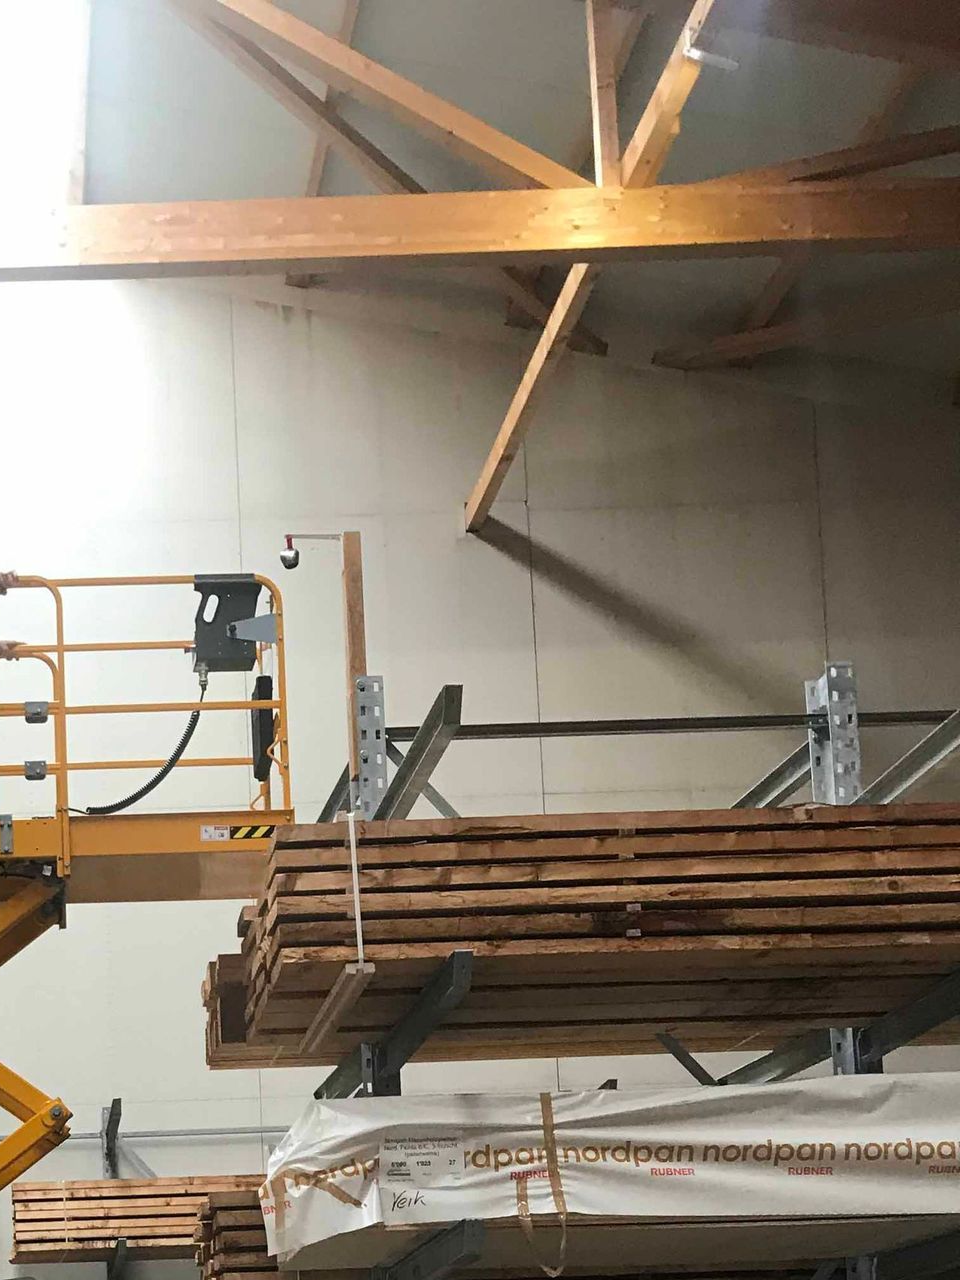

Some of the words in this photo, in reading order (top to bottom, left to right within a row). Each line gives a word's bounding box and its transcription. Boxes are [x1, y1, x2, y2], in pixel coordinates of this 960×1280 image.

[563, 1140, 694, 1167] nordpan
[702, 1139, 836, 1166] nordpan
[844, 1137, 960, 1165] nordpa
[650, 1167, 696, 1176] RUBNER
[788, 1166, 834, 1176] RUBNER
